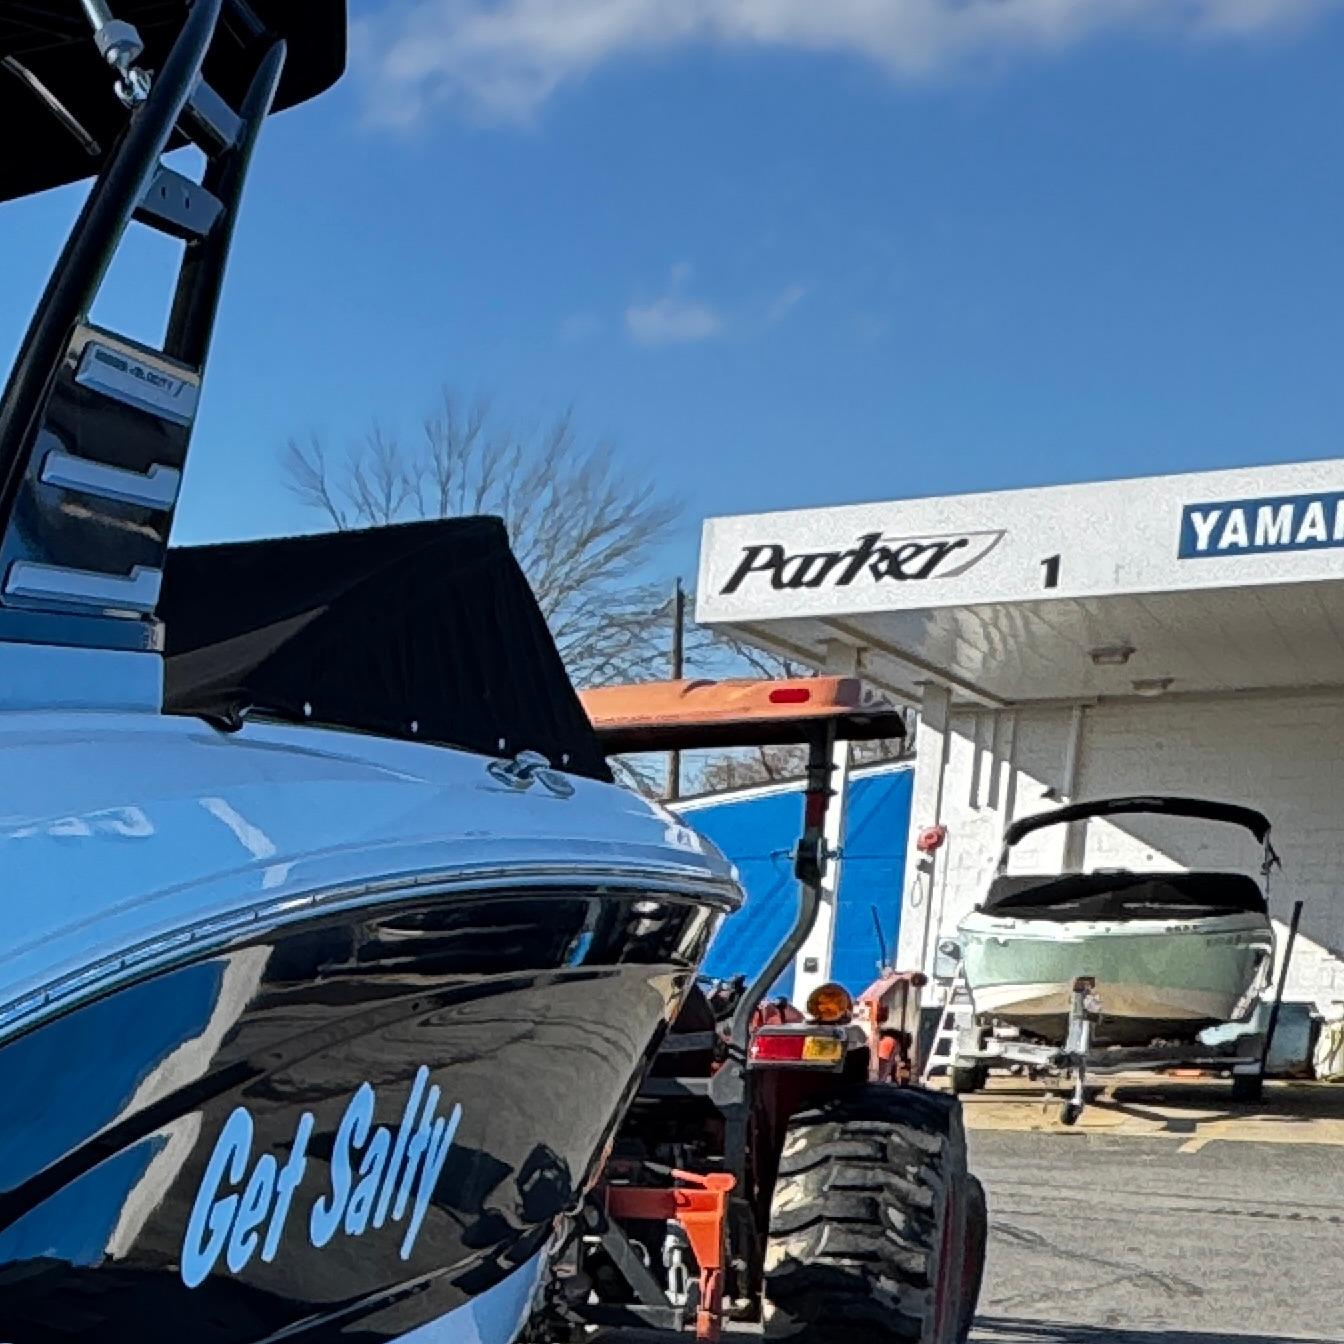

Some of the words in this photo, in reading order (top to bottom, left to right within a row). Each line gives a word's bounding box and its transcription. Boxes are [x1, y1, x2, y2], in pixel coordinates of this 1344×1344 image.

[719, 532, 970, 595] Parker
[1041, 554, 1061, 589] 1
[181, 1106, 315, 1288] Get
[310, 1064, 462, 1260] Salty
